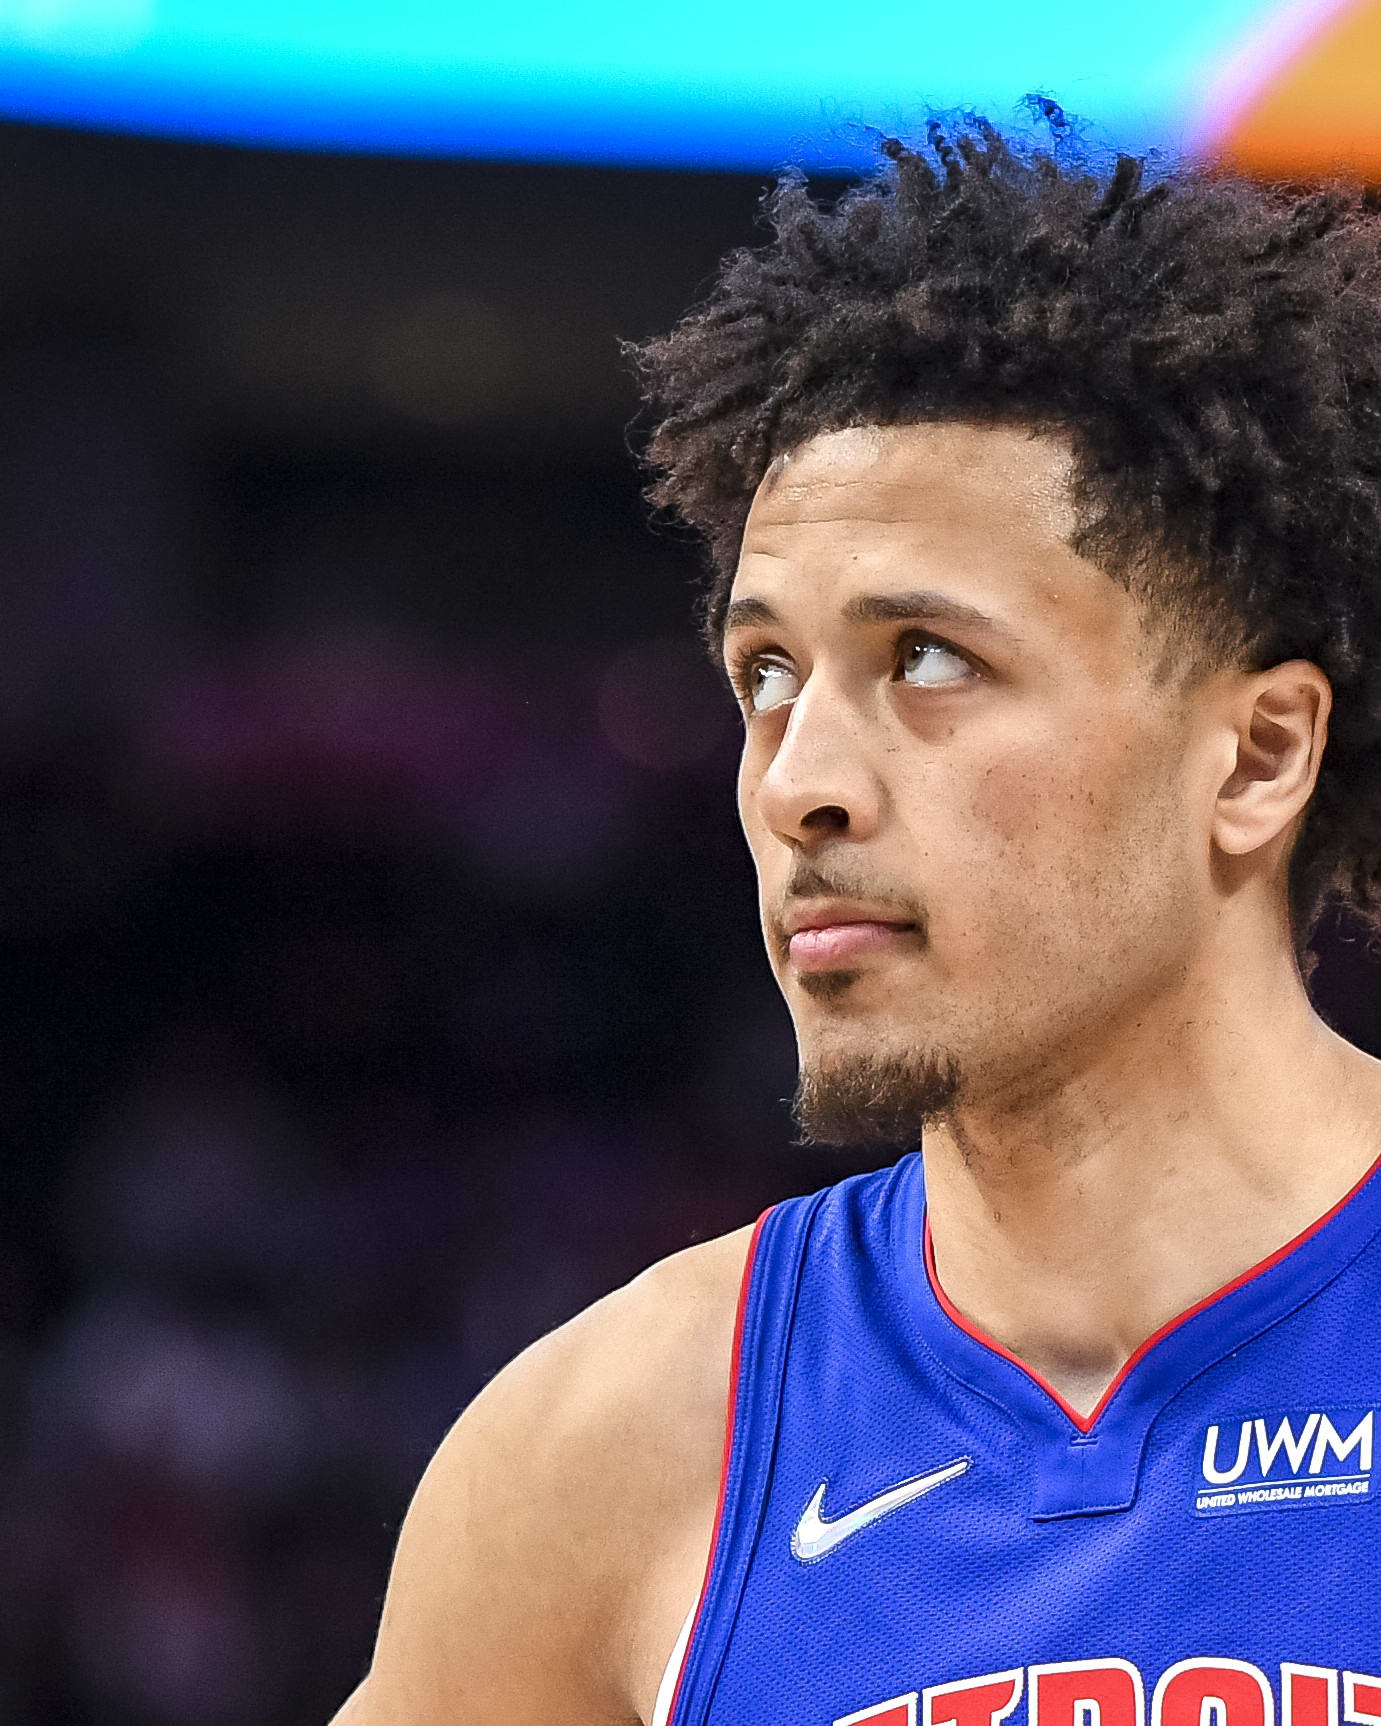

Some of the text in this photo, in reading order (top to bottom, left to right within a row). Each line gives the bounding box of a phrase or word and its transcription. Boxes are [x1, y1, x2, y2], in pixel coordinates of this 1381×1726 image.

[1202, 1410, 1374, 1484] UWM
[1196, 1480, 1369, 1509] UNITED WHOLESALE MORTGAGE
